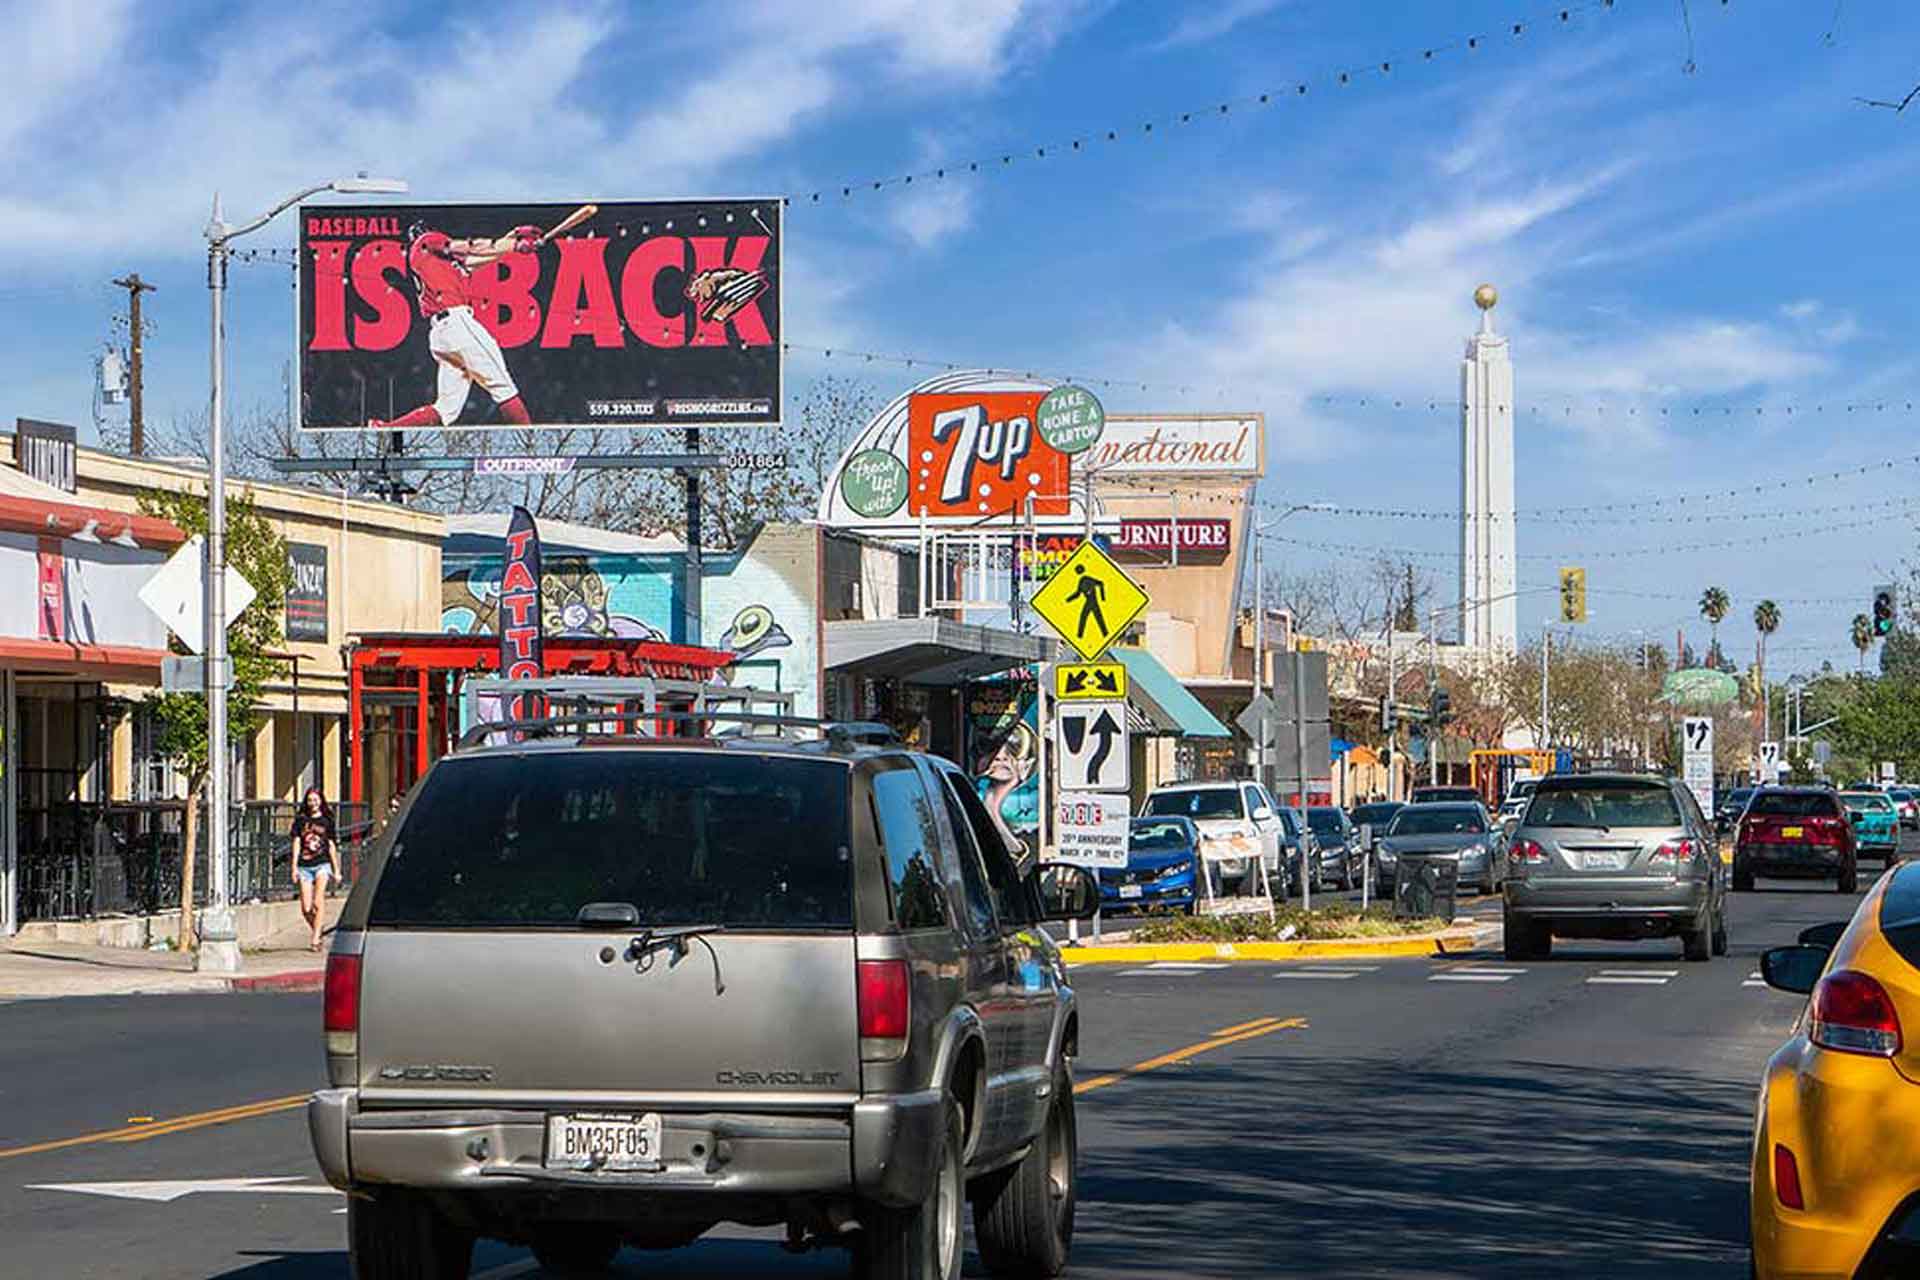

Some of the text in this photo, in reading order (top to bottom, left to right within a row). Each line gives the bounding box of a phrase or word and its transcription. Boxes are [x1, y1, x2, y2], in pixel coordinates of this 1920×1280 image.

[308, 217, 401, 236] BASEBALL
[308, 235, 774, 352] IS BACK
[1051, 391, 1083, 411] TAKE
[1088, 406, 1098, 421] A
[1091, 427, 1249, 465] national
[484, 459, 565, 472] OUTFRONT
[728, 454, 785, 469] 001864
[1120, 525, 1227, 545] URNITURE
[716, 1071, 841, 1085] CHEVROLET
[566, 1127, 648, 1156] BM35F05
